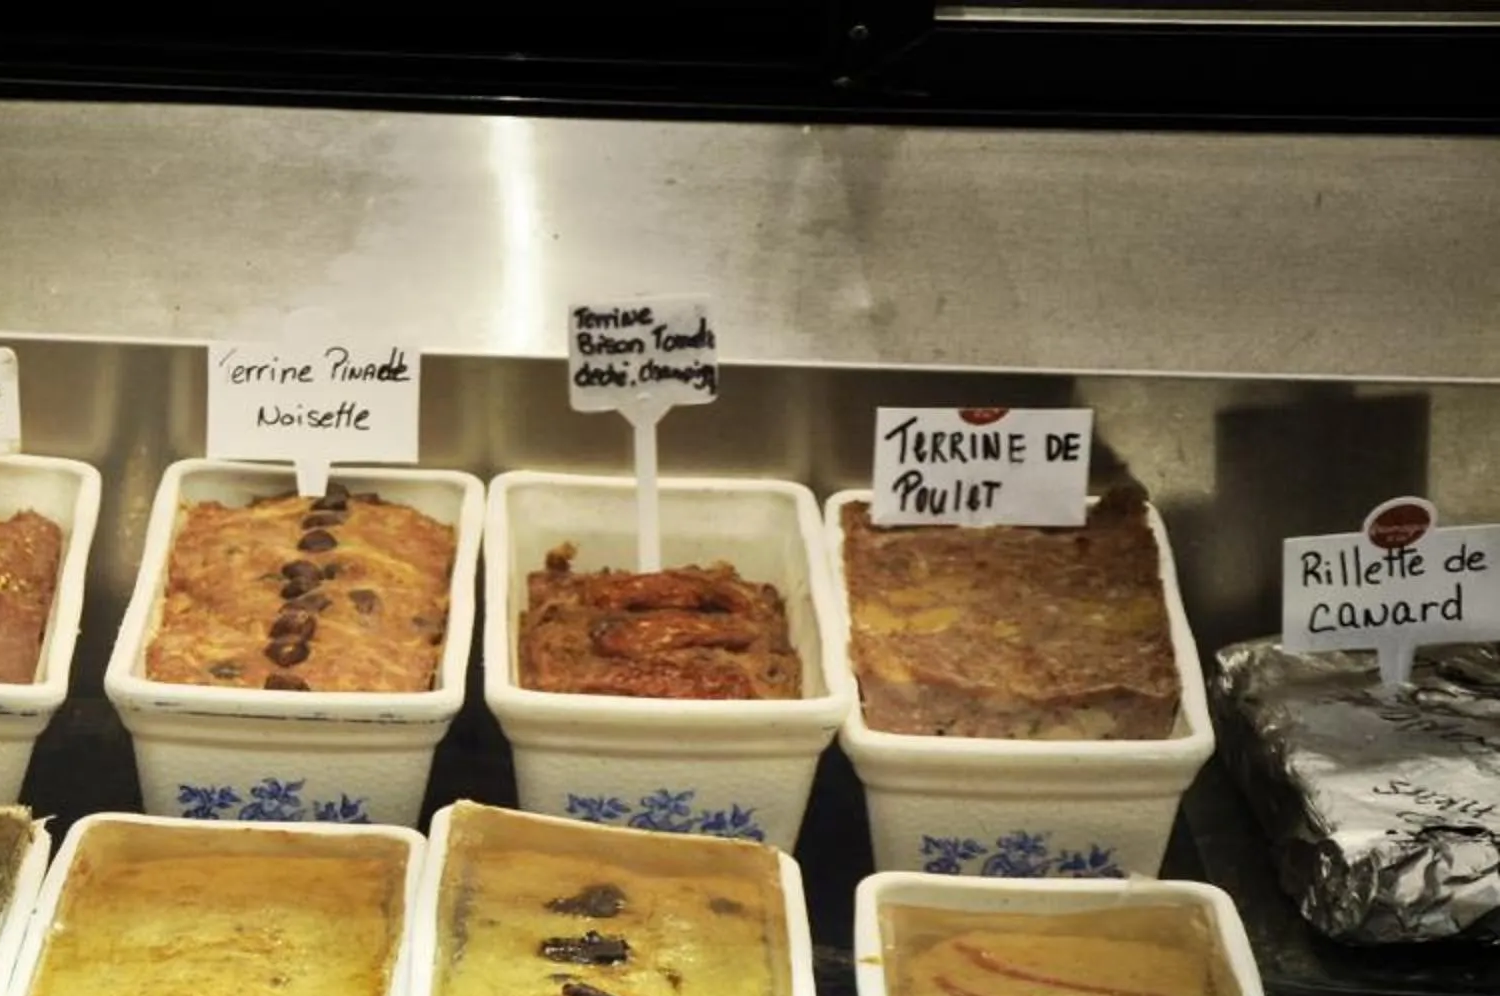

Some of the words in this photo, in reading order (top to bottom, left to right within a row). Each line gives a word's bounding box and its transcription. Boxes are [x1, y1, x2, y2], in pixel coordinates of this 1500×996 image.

[257, 401, 370, 430] Noisette
[1046, 433, 1080, 461] DE
[1301, 544, 1425, 588] Rillette
[1443, 543, 1488, 573] de
